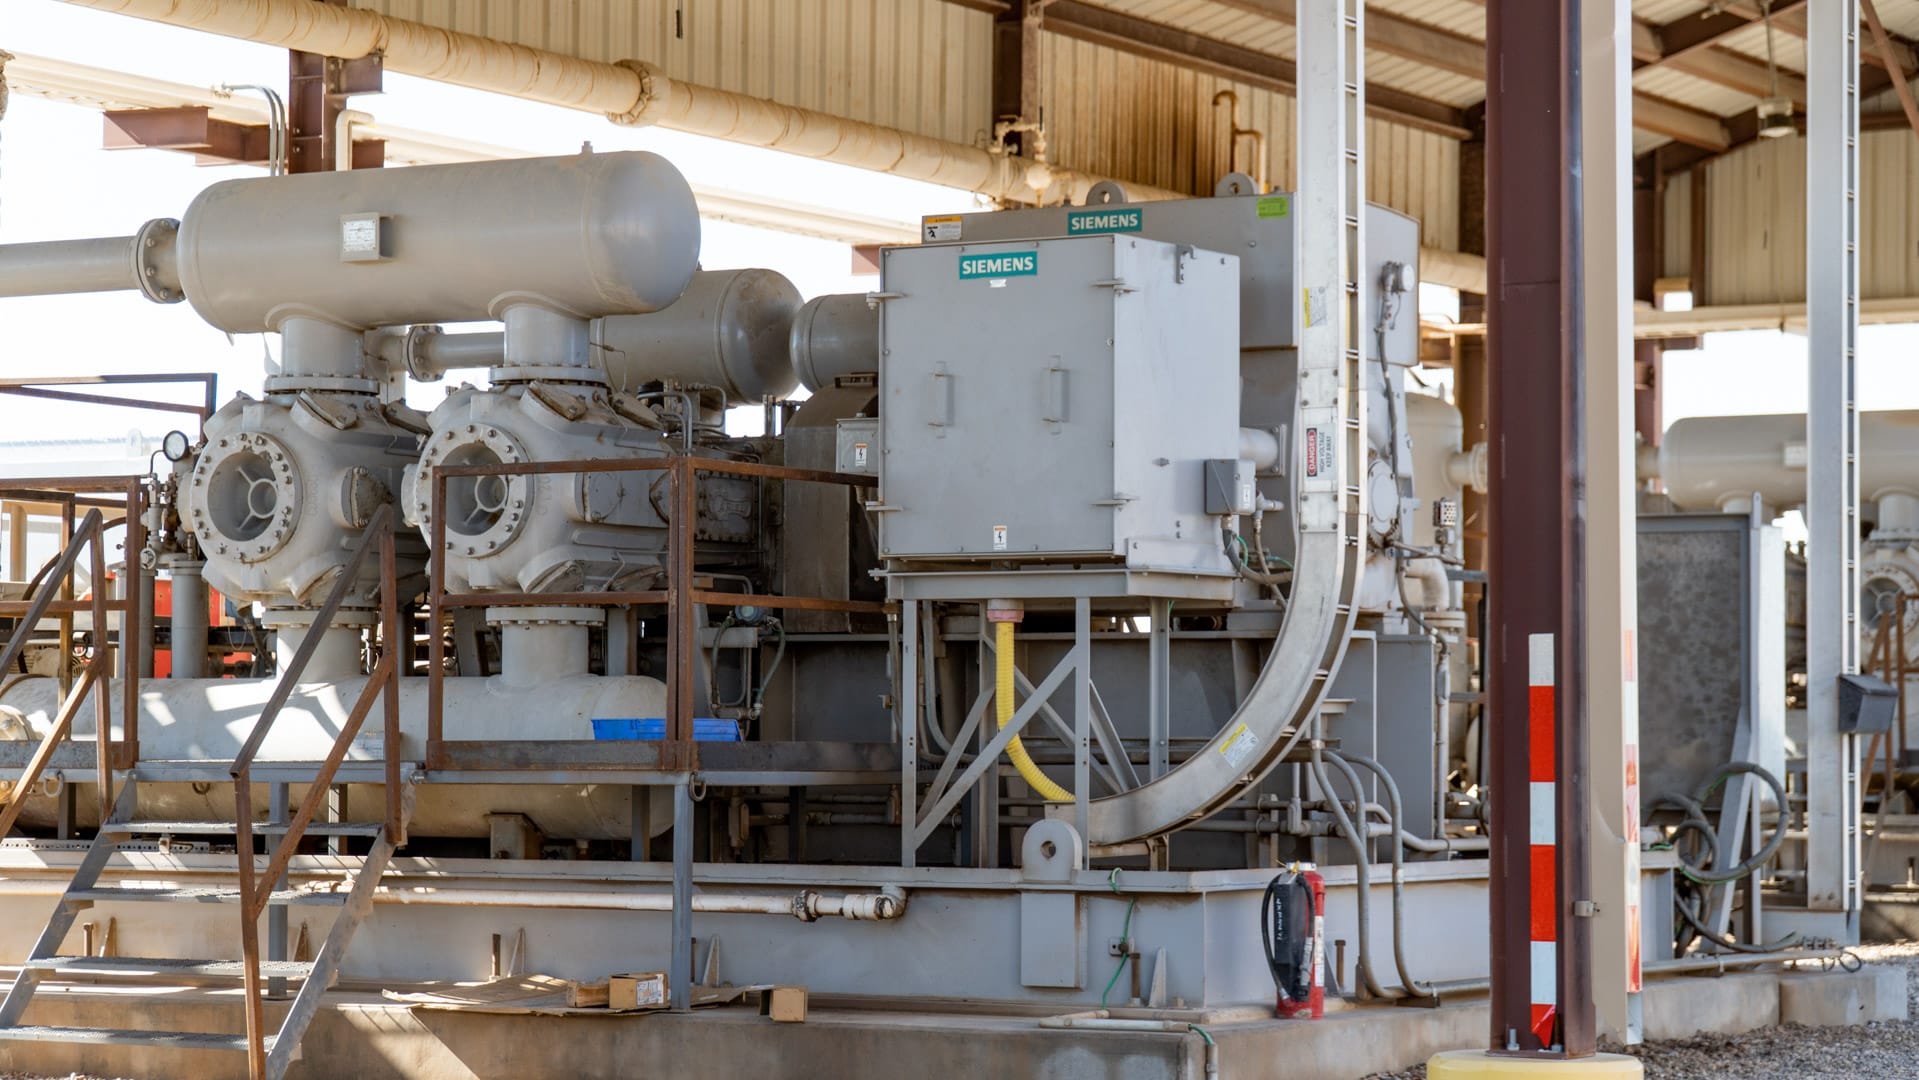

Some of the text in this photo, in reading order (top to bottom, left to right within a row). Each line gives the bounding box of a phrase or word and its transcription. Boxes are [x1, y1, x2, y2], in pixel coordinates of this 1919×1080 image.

[1071, 213, 1138, 230] SIEMENS
[962, 256, 1034, 275] SIEMENS
[1308, 435, 1316, 470] DANGER
